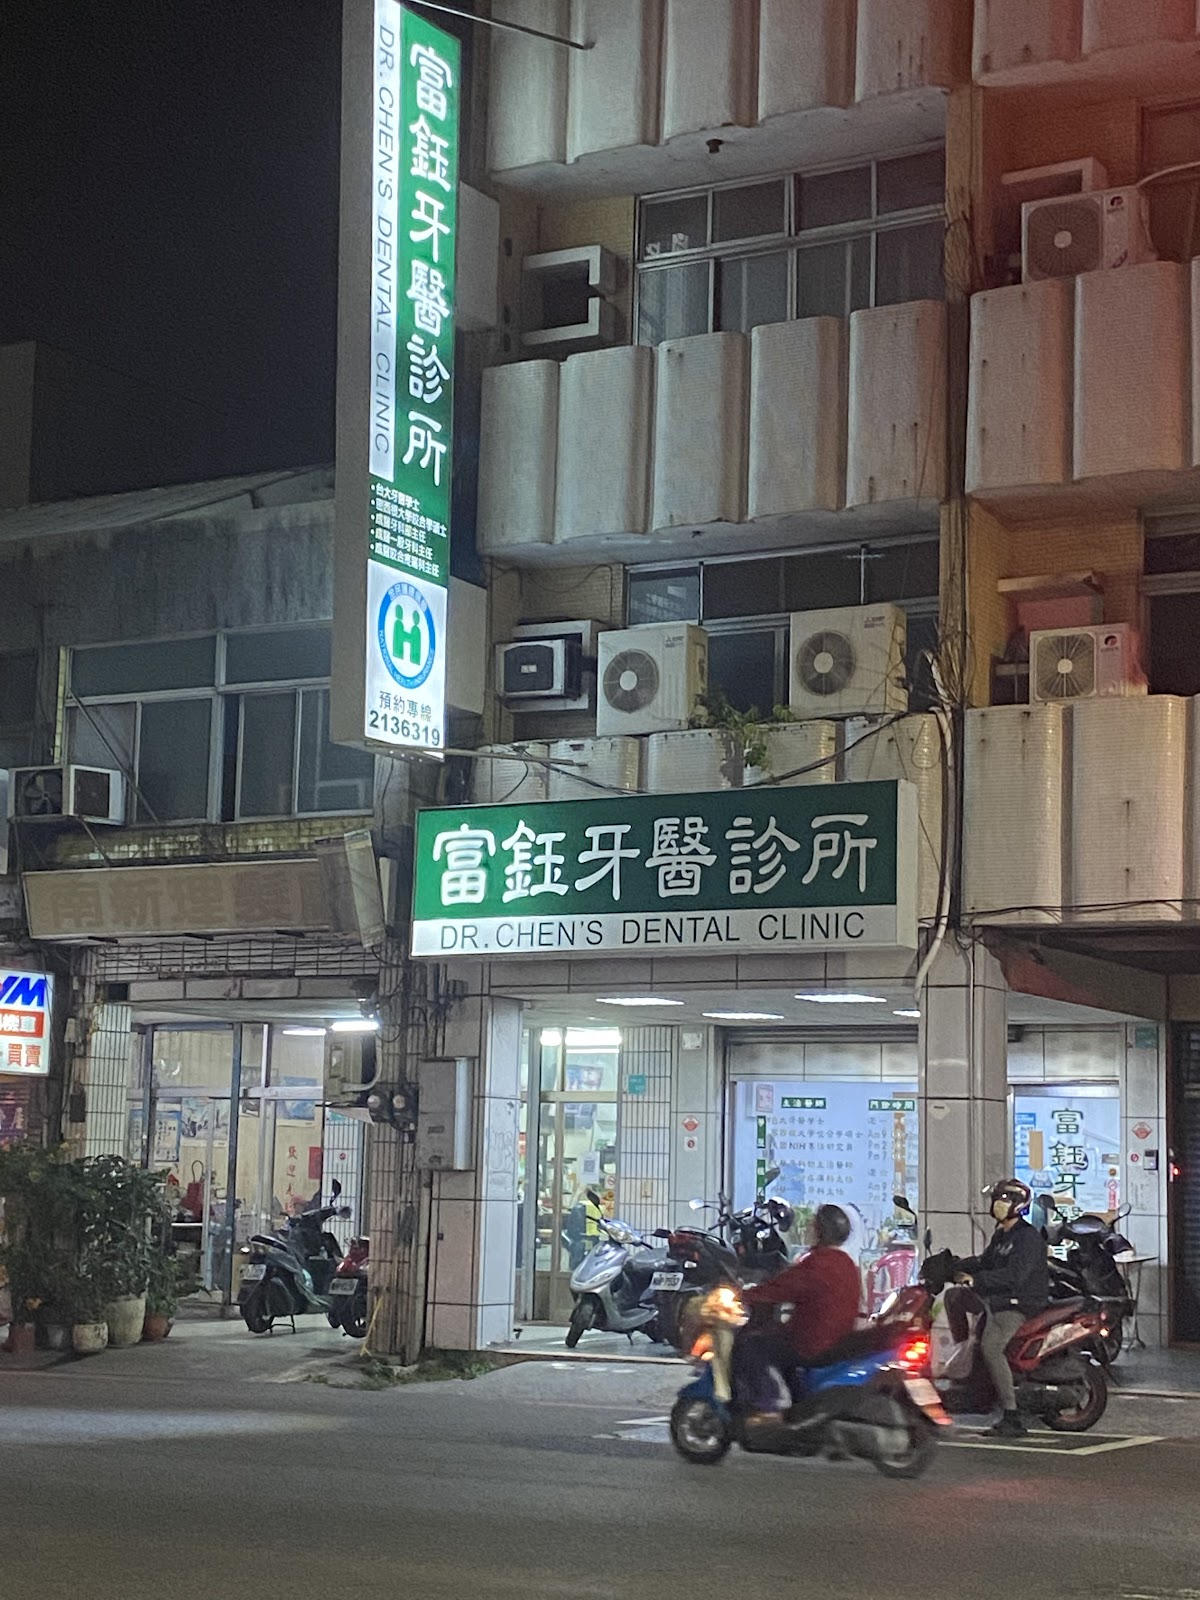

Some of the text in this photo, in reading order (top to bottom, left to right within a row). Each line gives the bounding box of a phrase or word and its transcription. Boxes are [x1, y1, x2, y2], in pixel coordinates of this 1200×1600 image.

[375, 24, 395, 455] DR. CHEN'S DENTAL CLINIC
[403, 43, 453, 486] 富鈺牙醫診所
[379, 690, 432, 722] 預約專線
[369, 710, 441, 746] 2136319
[432, 813, 878, 906] 富鈺牙醫診所
[496, 920, 604, 947] CHEN'S
[622, 917, 741, 945] DENTAL
[758, 912, 865, 941] CLINIC
[0, 1014, 37, 1033] 機車
[8, 1043, 42, 1068] 買賣
